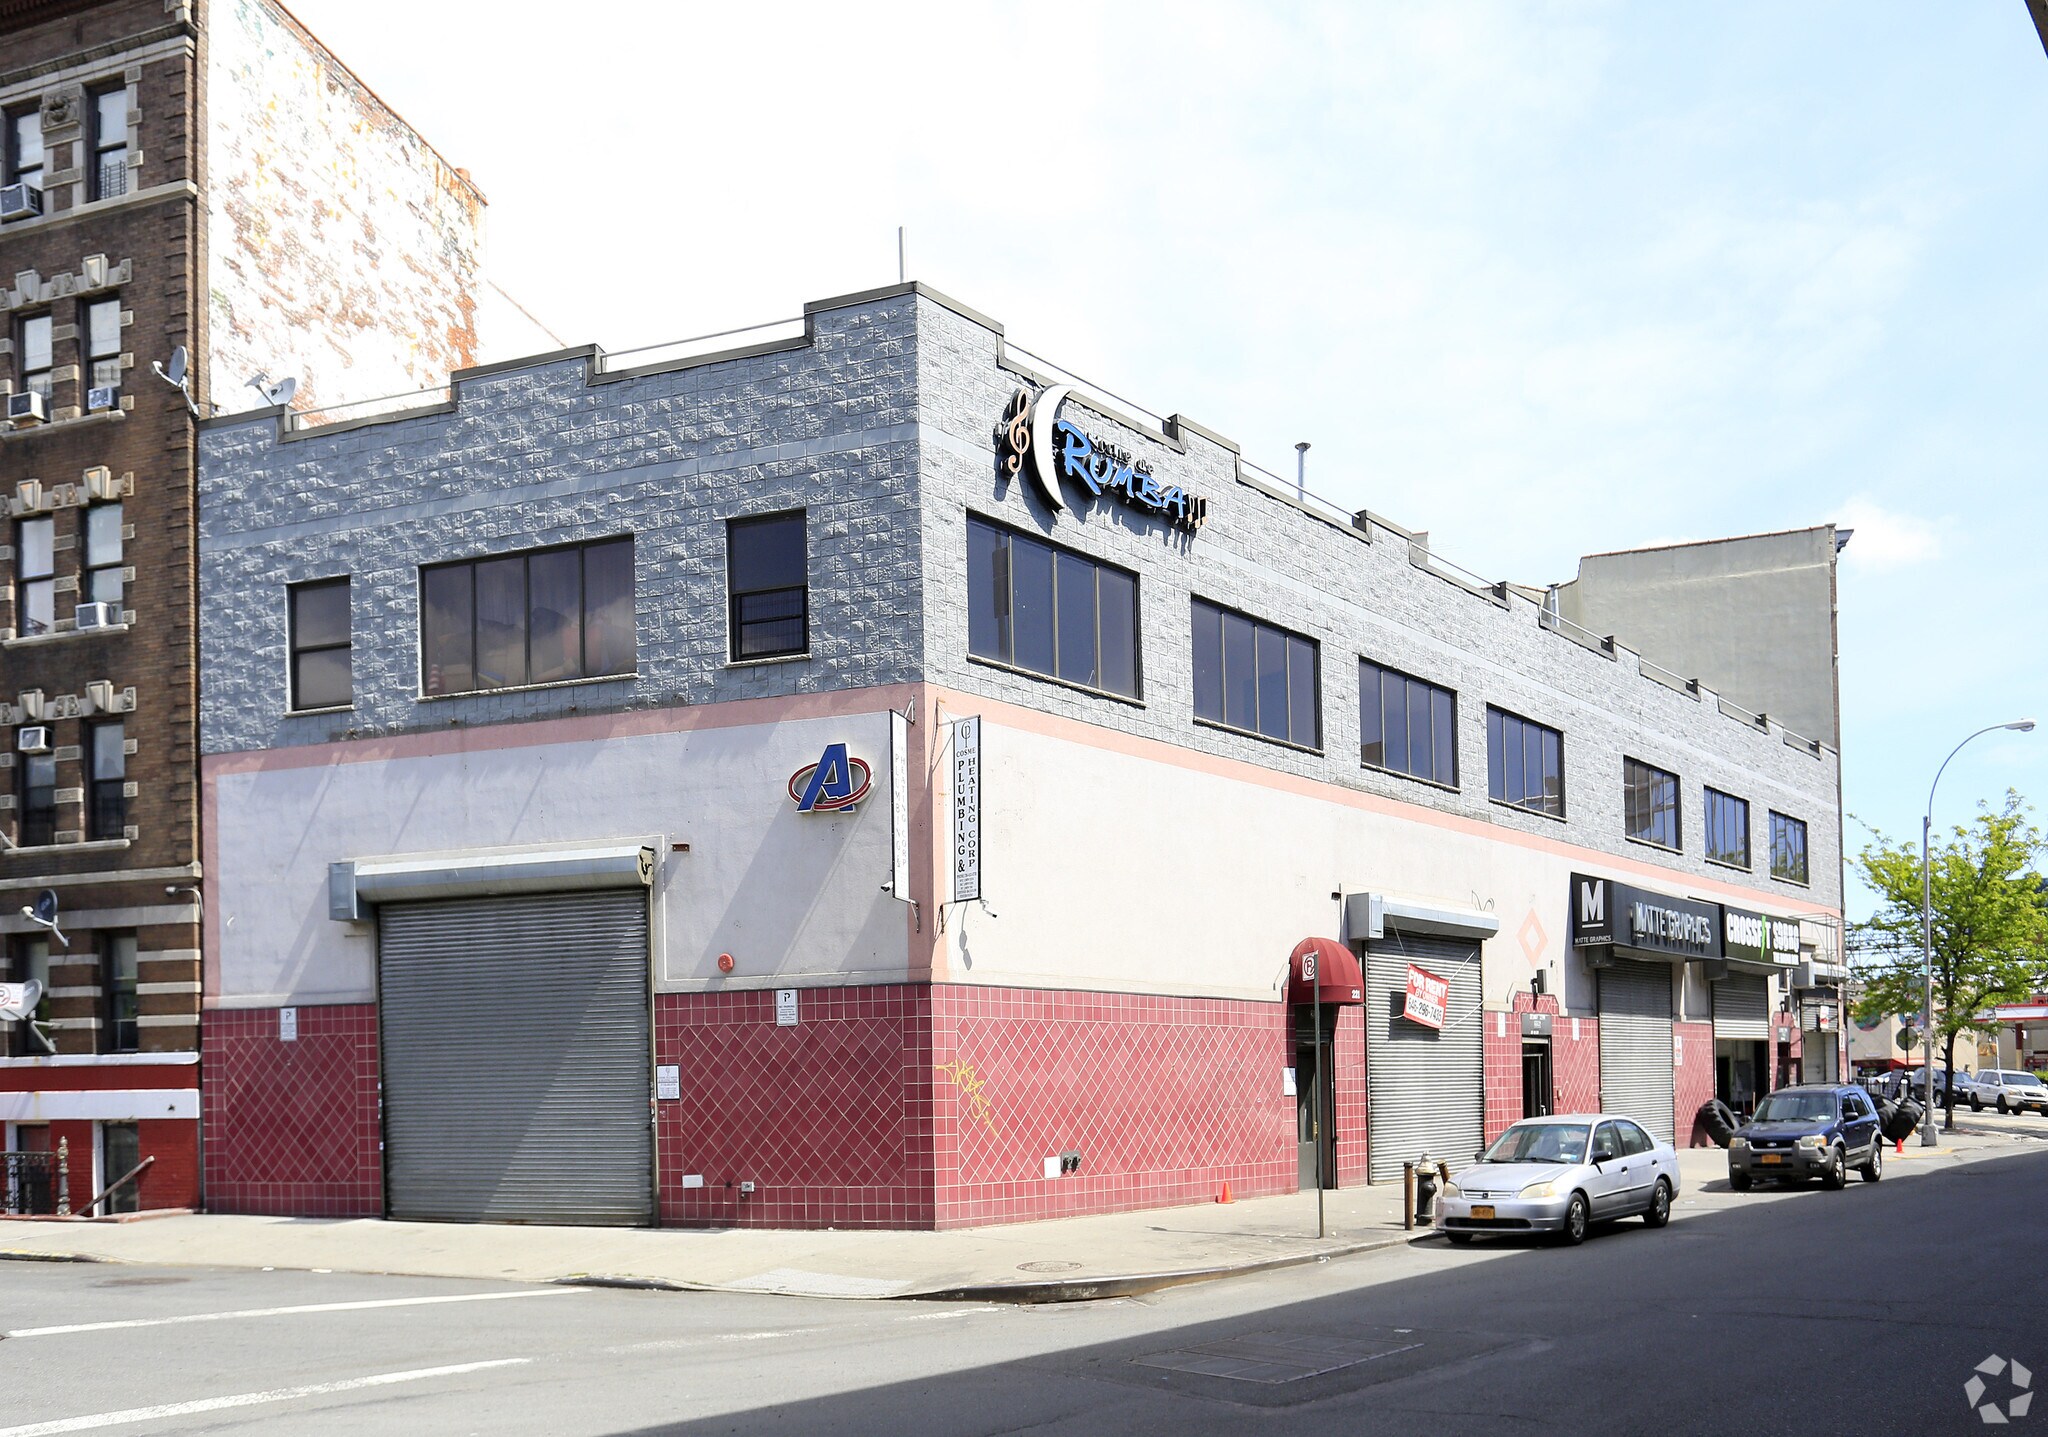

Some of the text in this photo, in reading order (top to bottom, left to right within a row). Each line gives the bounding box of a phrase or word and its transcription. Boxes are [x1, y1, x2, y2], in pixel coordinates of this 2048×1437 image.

[1058, 419, 1186, 518] RUMBA
[956, 747, 976, 758] COSME
[967, 757, 976, 823] HEATING
[957, 760, 966, 873] PLUMBING &
[967, 830, 976, 868] CORP
[1581, 880, 1604, 922] M
[1574, 934, 1612, 944] MATTE GRAPHICS
[1633, 901, 1712, 945] MATTE GRAPHICS
[1408, 969, 1448, 999] FOR RENT
[1415, 987, 1424, 999] BY
